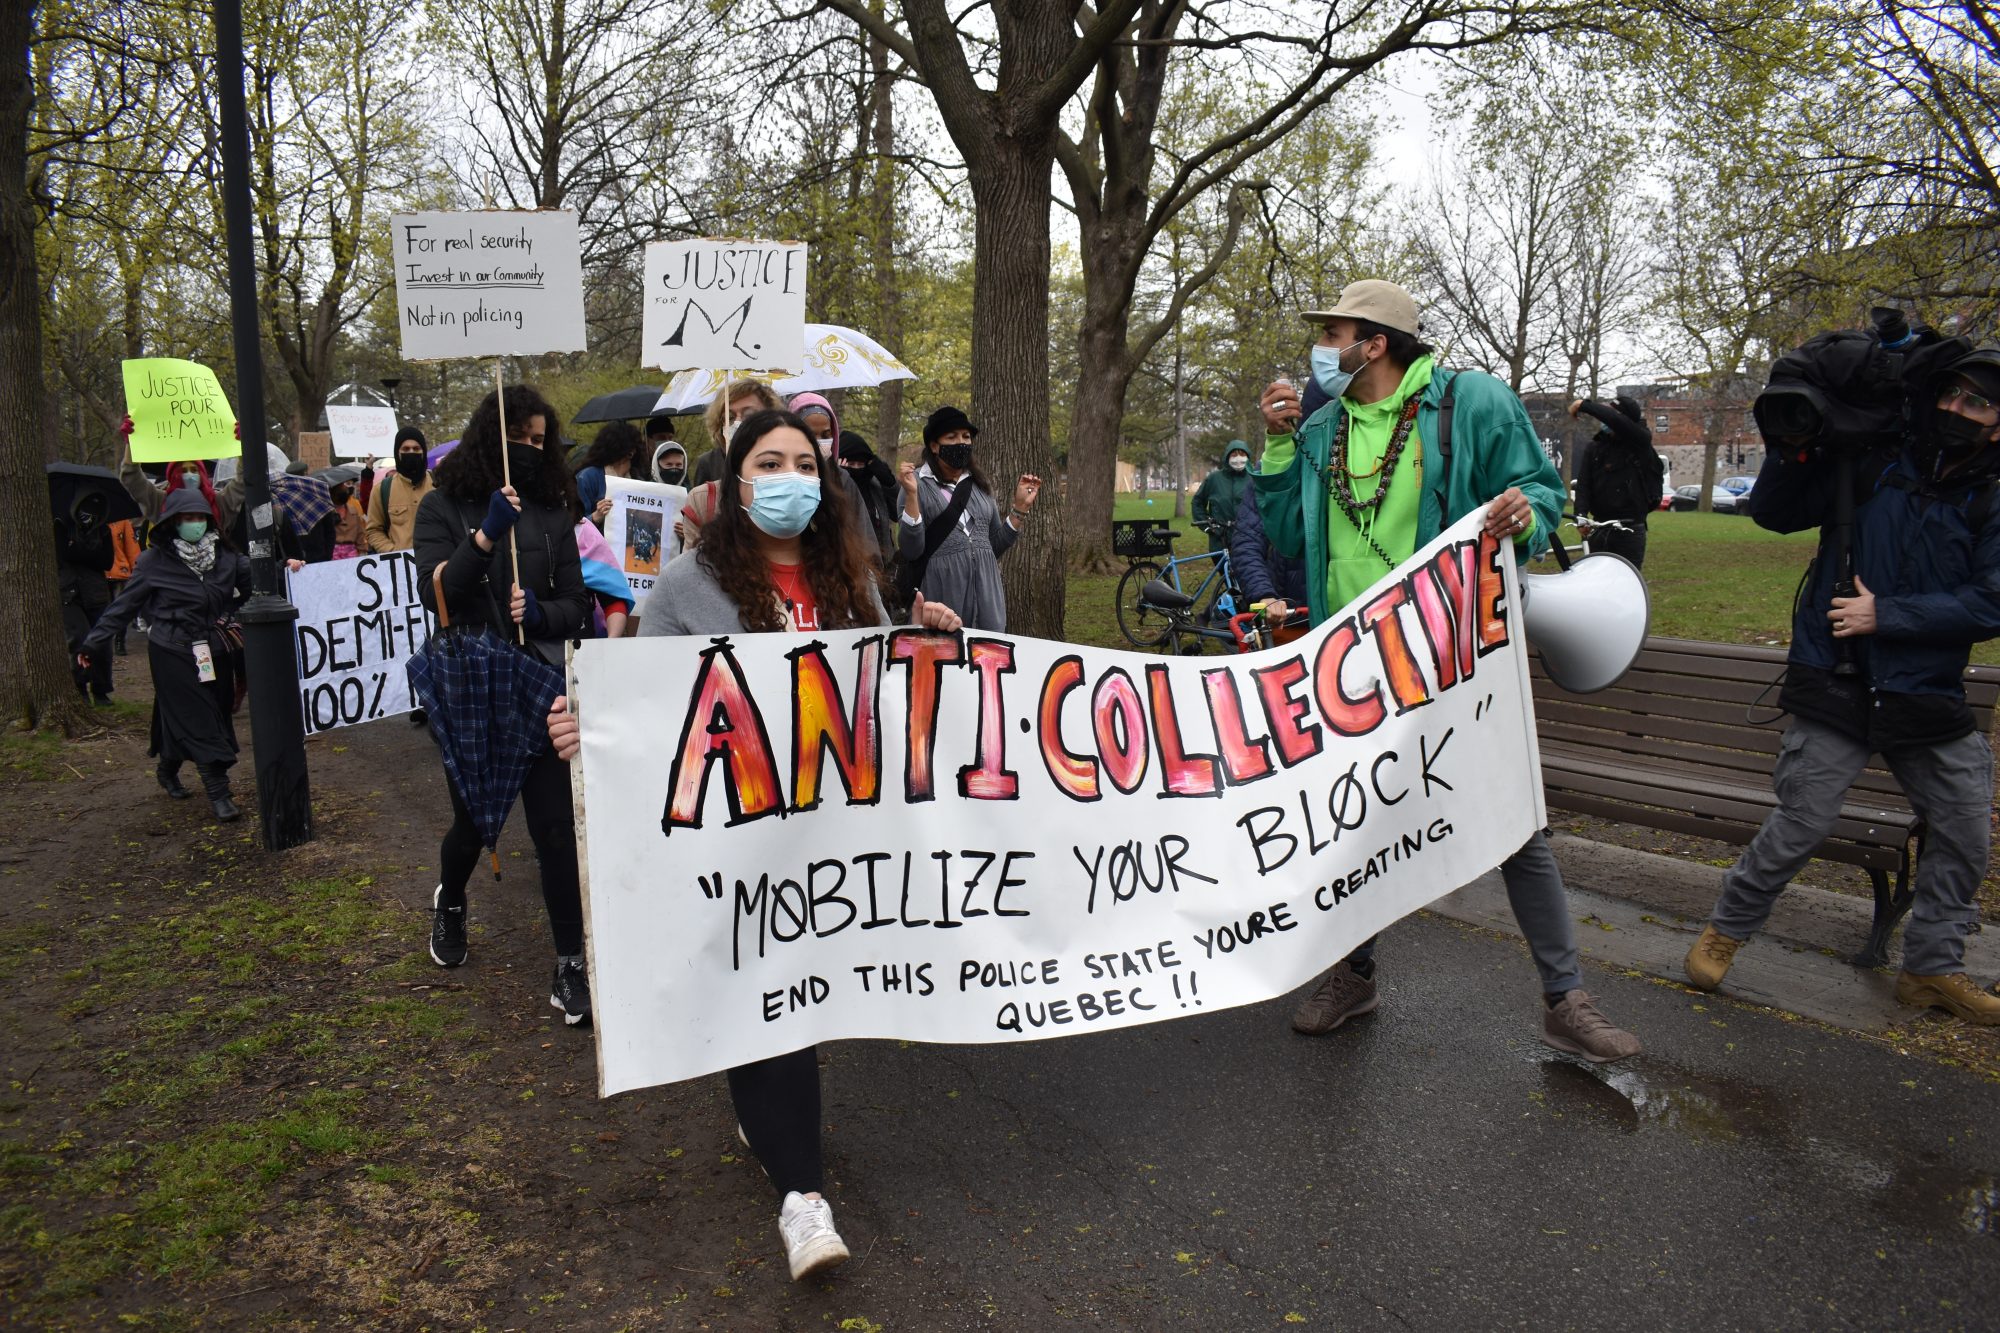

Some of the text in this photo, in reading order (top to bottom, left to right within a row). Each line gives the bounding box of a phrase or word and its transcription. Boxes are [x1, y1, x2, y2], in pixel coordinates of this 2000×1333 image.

[404, 225, 532, 255] For real security
[405, 262, 545, 285] Invest in our Community
[663, 249, 802, 294] JUSTICE
[655, 296, 678, 304] FOR
[463, 298, 523, 337] policing
[141, 370, 219, 399] JUSTICE
[170, 398, 216, 416] POUR
[627, 495, 645, 505] THIS
[647, 498, 655, 506] IS
[303, 672, 388, 734] 100%
[763, 817, 1454, 1022] END THIS POLICE STATE YOURE CREATING
[995, 986, 1155, 1033] QUEBEC
